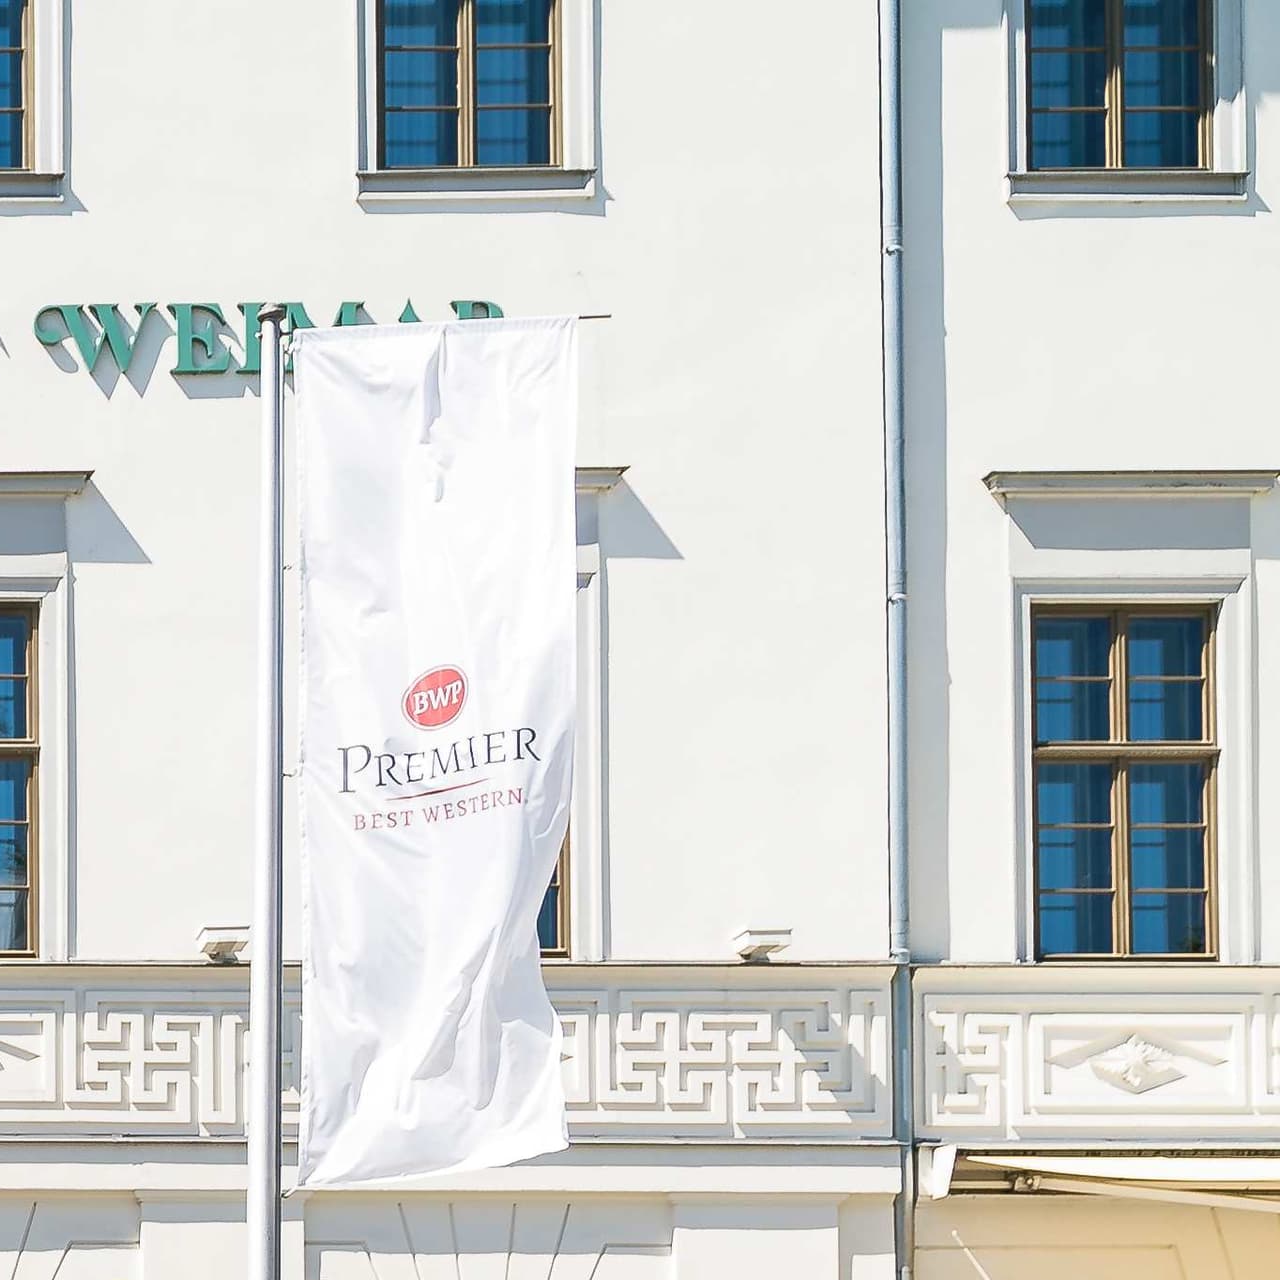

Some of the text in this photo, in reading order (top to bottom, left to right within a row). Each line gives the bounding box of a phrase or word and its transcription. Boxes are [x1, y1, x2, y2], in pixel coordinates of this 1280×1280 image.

[411, 679, 463, 716] BWP
[337, 727, 541, 794] PREMIER
[353, 787, 525, 831] BEST WESTERN
